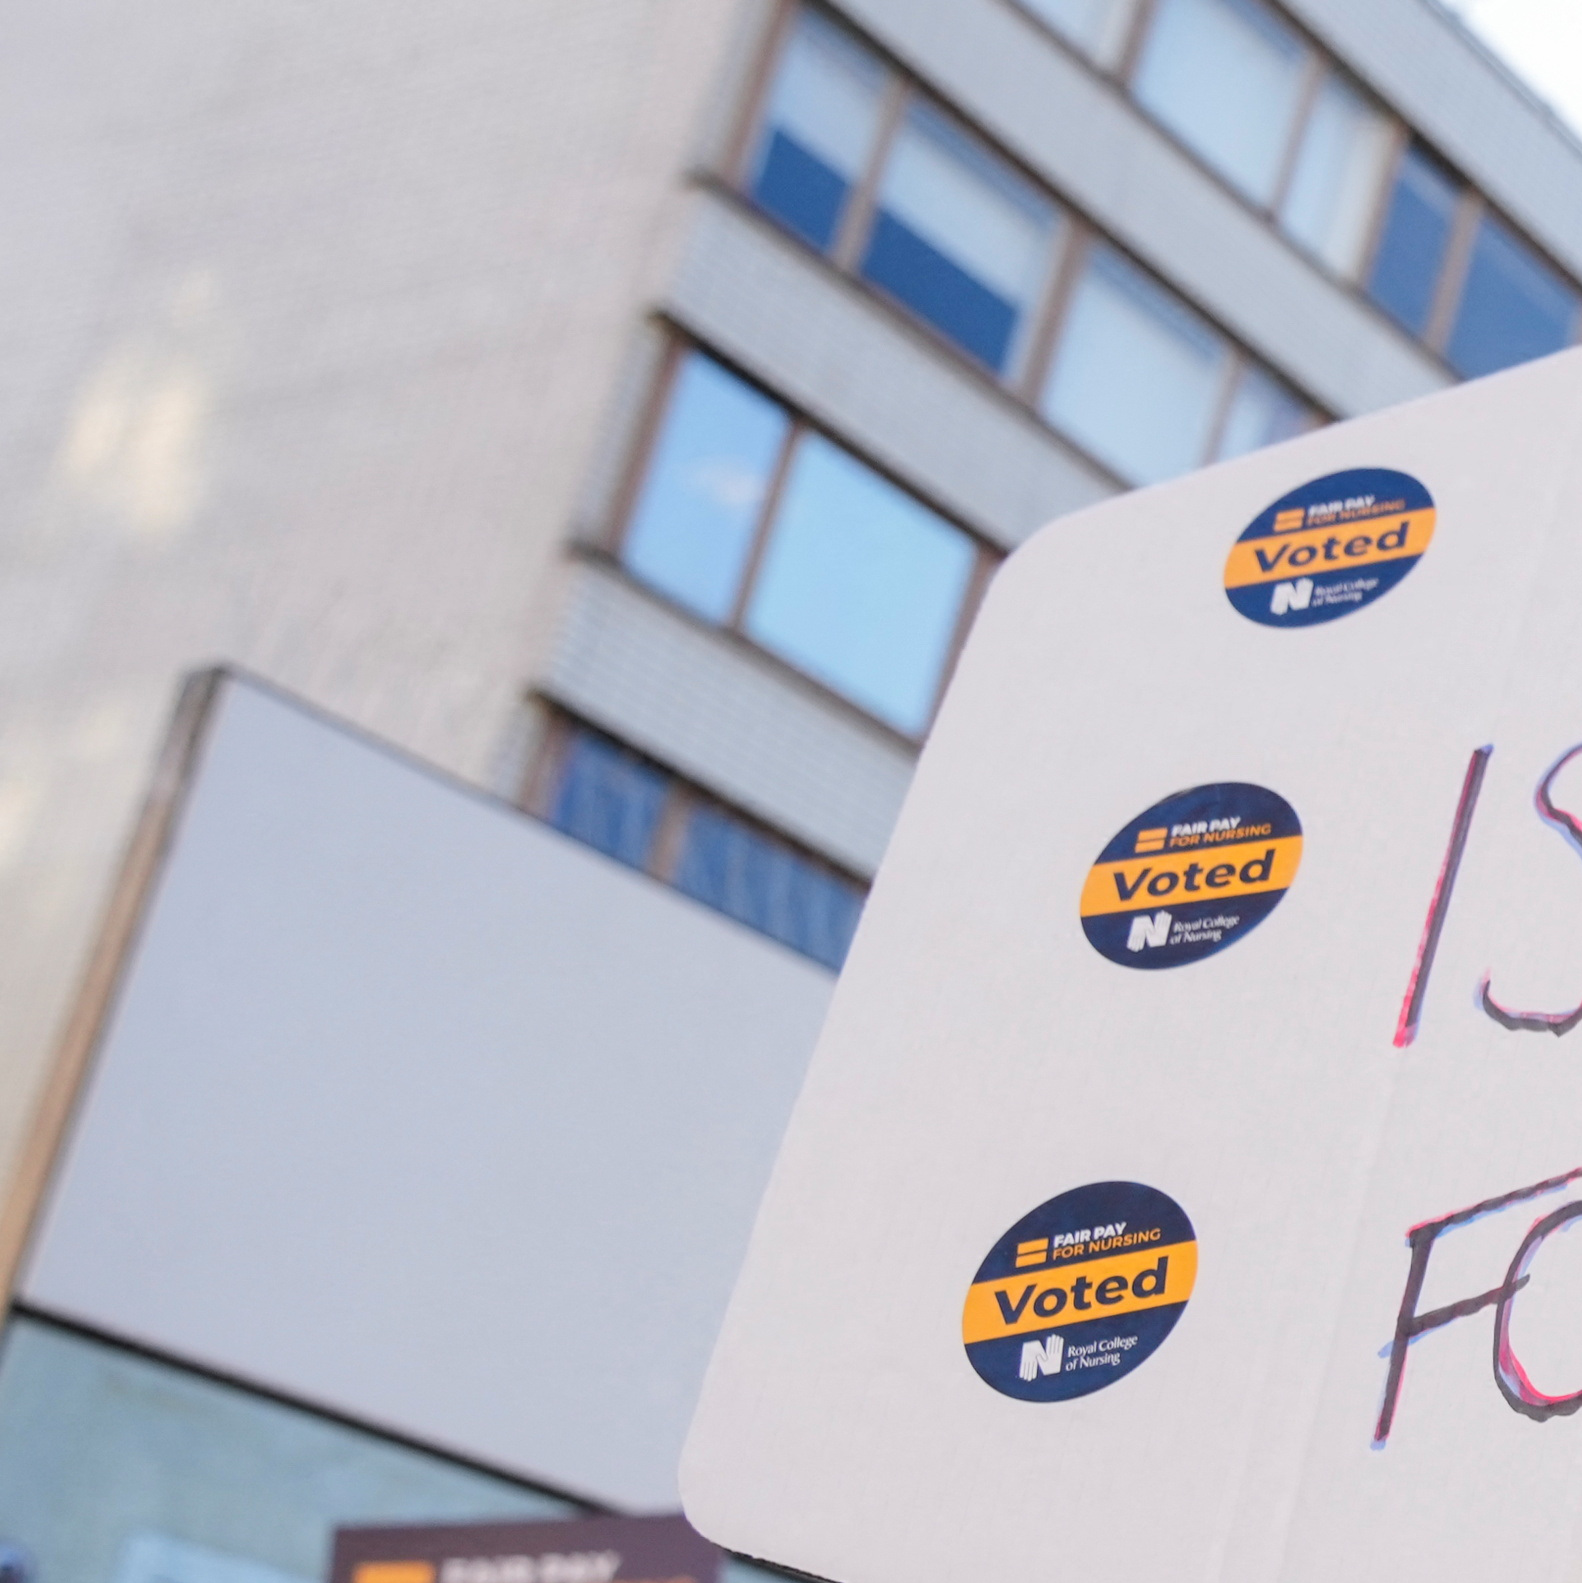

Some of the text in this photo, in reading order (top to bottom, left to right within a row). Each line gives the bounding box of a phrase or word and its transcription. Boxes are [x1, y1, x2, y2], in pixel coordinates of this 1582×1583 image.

[1254, 521, 1409, 573] Voted
[1169, 823, 1272, 849] FOR NURSING
[1171, 816, 1242, 837] FAIR PAY
[1113, 848, 1276, 902] Voted
[1173, 915, 1240, 935] Royal College
[1183, 926, 1222, 943] Nursing
[1052, 1228, 1162, 1261] FOR NURSING
[1053, 1221, 1127, 1248] FAIR PAY
[994, 1255, 1170, 1326] Voted
[1067, 1335, 1138, 1358] Royal College
[1065, 1352, 1121, 1372] of Nursing
